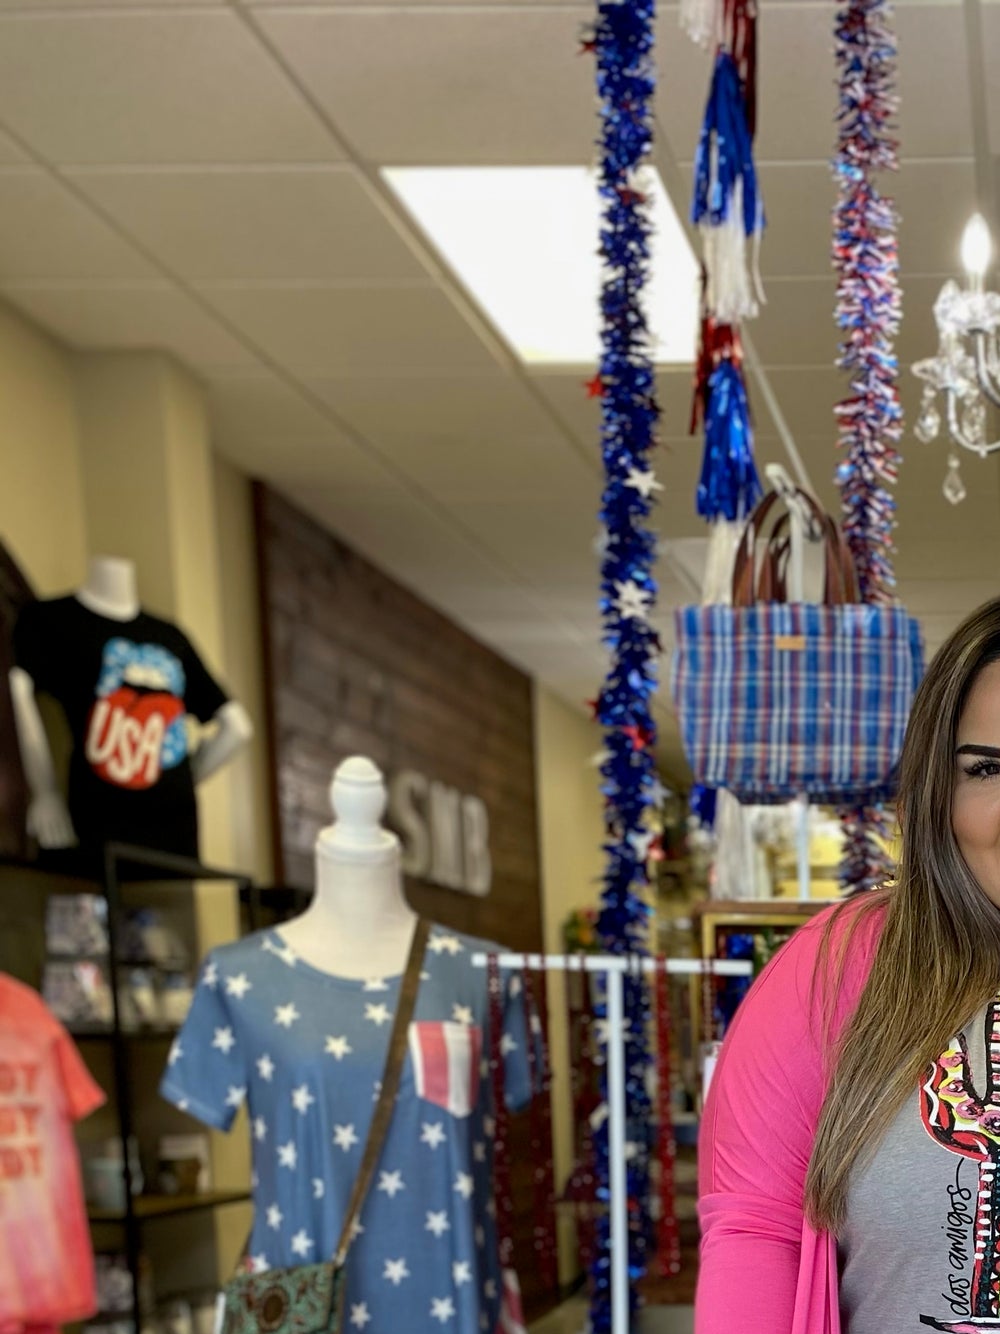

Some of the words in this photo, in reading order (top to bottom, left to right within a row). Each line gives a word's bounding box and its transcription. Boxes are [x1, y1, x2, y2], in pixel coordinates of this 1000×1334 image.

[85, 698, 166, 784] USA
[941, 1157, 974, 1270] amigos
[942, 1274, 970, 1316] dos
